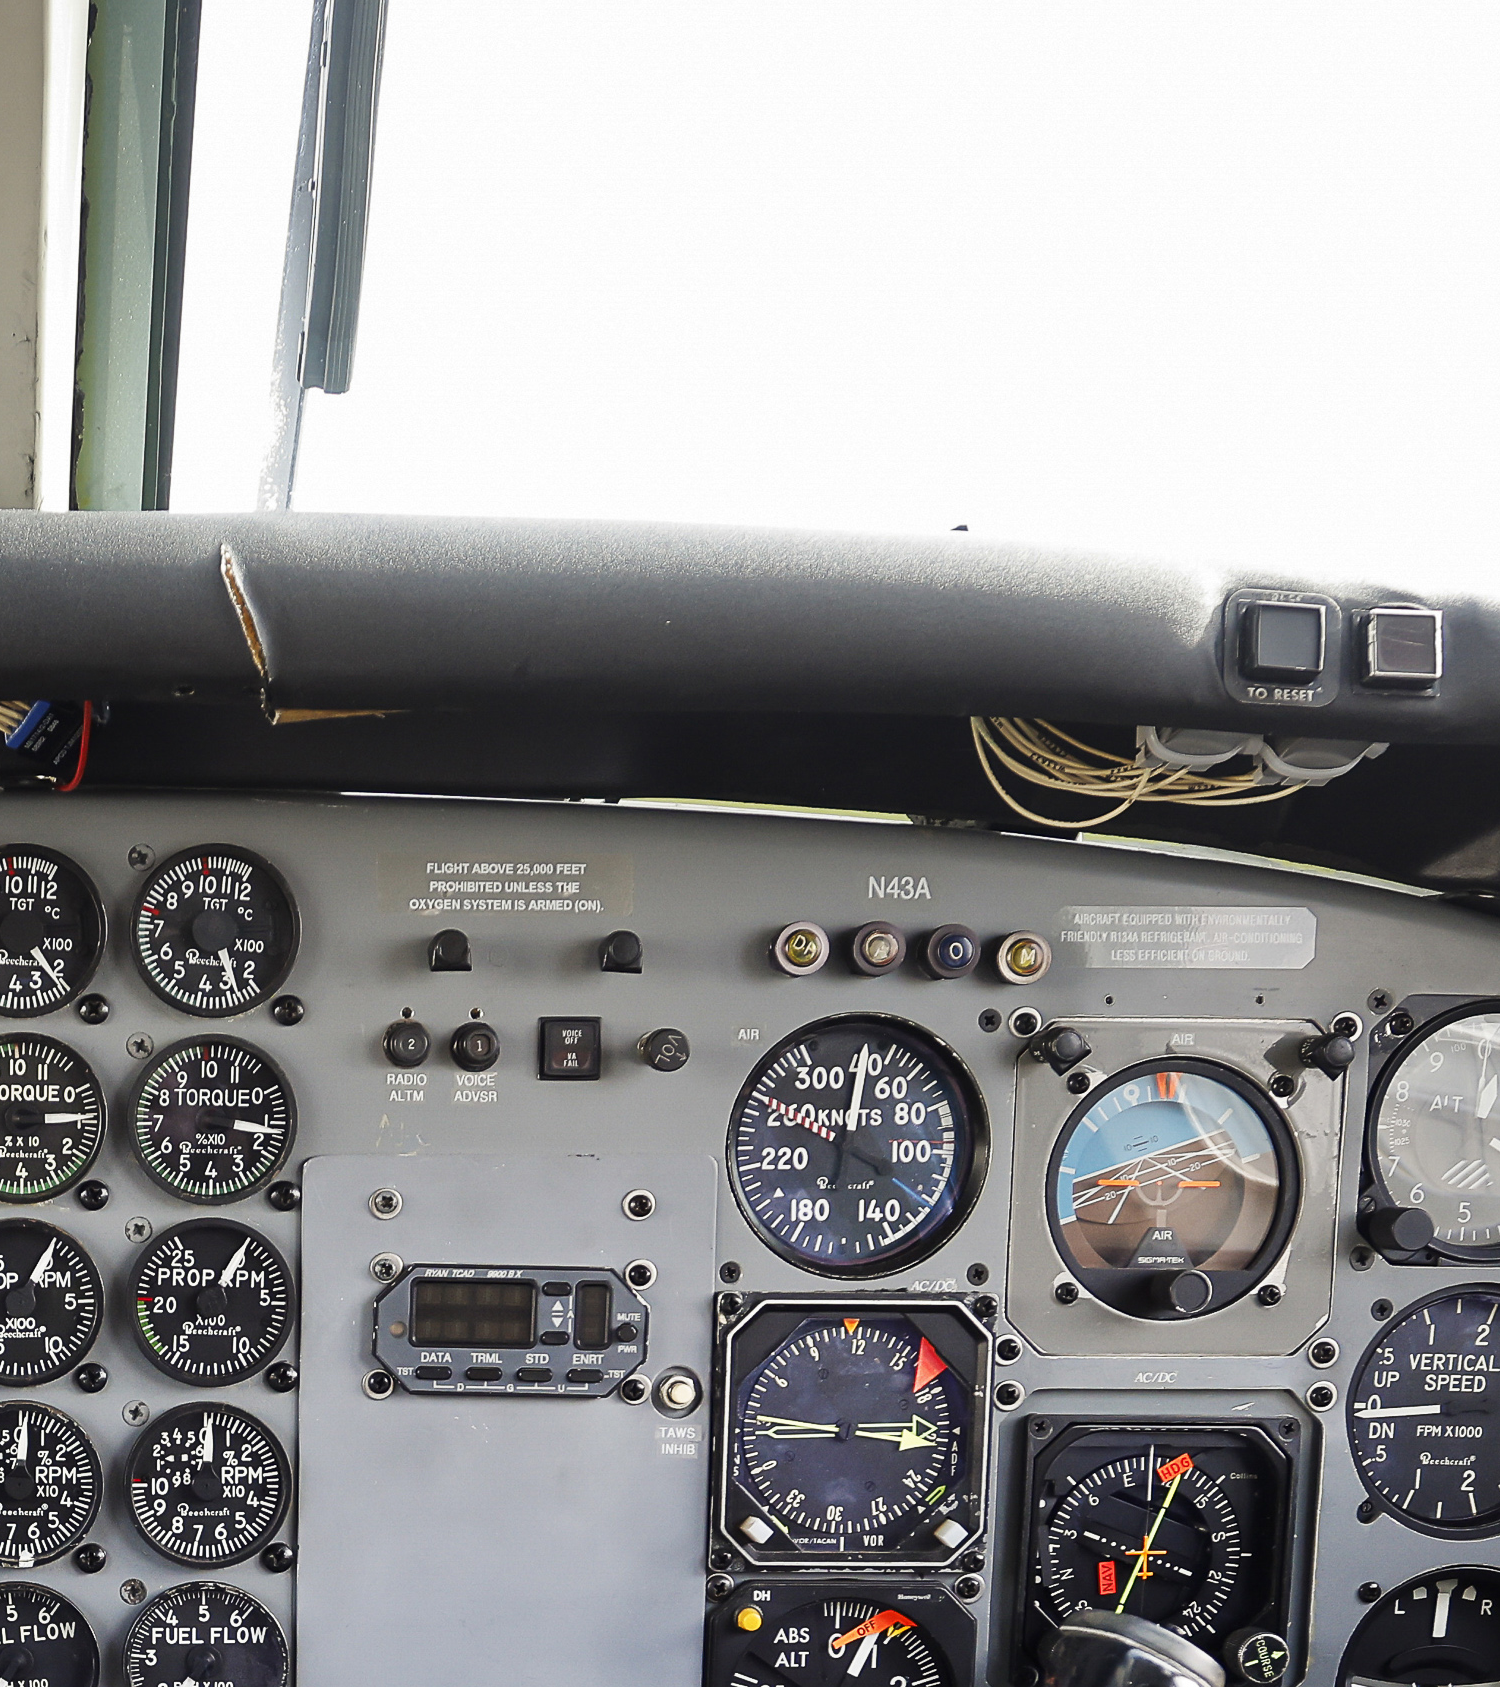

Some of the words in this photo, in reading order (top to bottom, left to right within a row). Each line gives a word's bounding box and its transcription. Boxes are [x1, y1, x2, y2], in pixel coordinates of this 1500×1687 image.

[1247, 687, 1267, 699] TO
[1274, 689, 1314, 701] RESET
[426, 863, 470, 875] FLIGHT
[472, 863, 514, 875] ABOVE
[516, 863, 554, 876] 25,000
[557, 863, 586, 875] FEET
[430, 881, 502, 893] PROHIBITED
[505, 881, 554, 893] UNLESS
[557, 882, 580, 893] THE
[868, 877, 932, 900] N43A
[10, 899, 34, 911] TGT
[410, 899, 460, 910] OXYGEN
[463, 899, 512, 911] SYSTEM
[514, 900, 525, 910] IS
[528, 900, 572, 911] ARMED
[574, 900, 604, 913] (ON).
[1074, 914, 1120, 925] AIRCRAFT
[1123, 914, 1172, 925] EQUIPPED
[1061, 931, 1108, 942] FRIENDLY
[1111, 950, 1135, 961] LESS
[1138, 951, 1189, 961] EFFICIENT
[387, 1074, 427, 1086] RADIO
[456, 1074, 495, 1086] VOICE
[389, 1090, 424, 1102] ALTM
[454, 1090, 497, 1102] ADVSR
[761, 1147, 808, 1170] 220
[1151, 1229, 1173, 1242] AIR
[617, 1313, 641, 1321] MUTE
[421, 1353, 452, 1364] DATA
[471, 1353, 502, 1364] TRML
[525, 1353, 550, 1364] STD
[1408, 1353, 1500, 1375] VERTICAL
[1424, 1374, 1487, 1394] SPEED
[659, 1427, 696, 1439] TAWS
[661, 1443, 696, 1456] INHIB
[35, 1467, 77, 1484] RPM
[20, 1622, 76, 1642] FLOW
[856, 1619, 877, 1638] OFF
[774, 1627, 810, 1644] ABS
[775, 1651, 810, 1668] ALT
